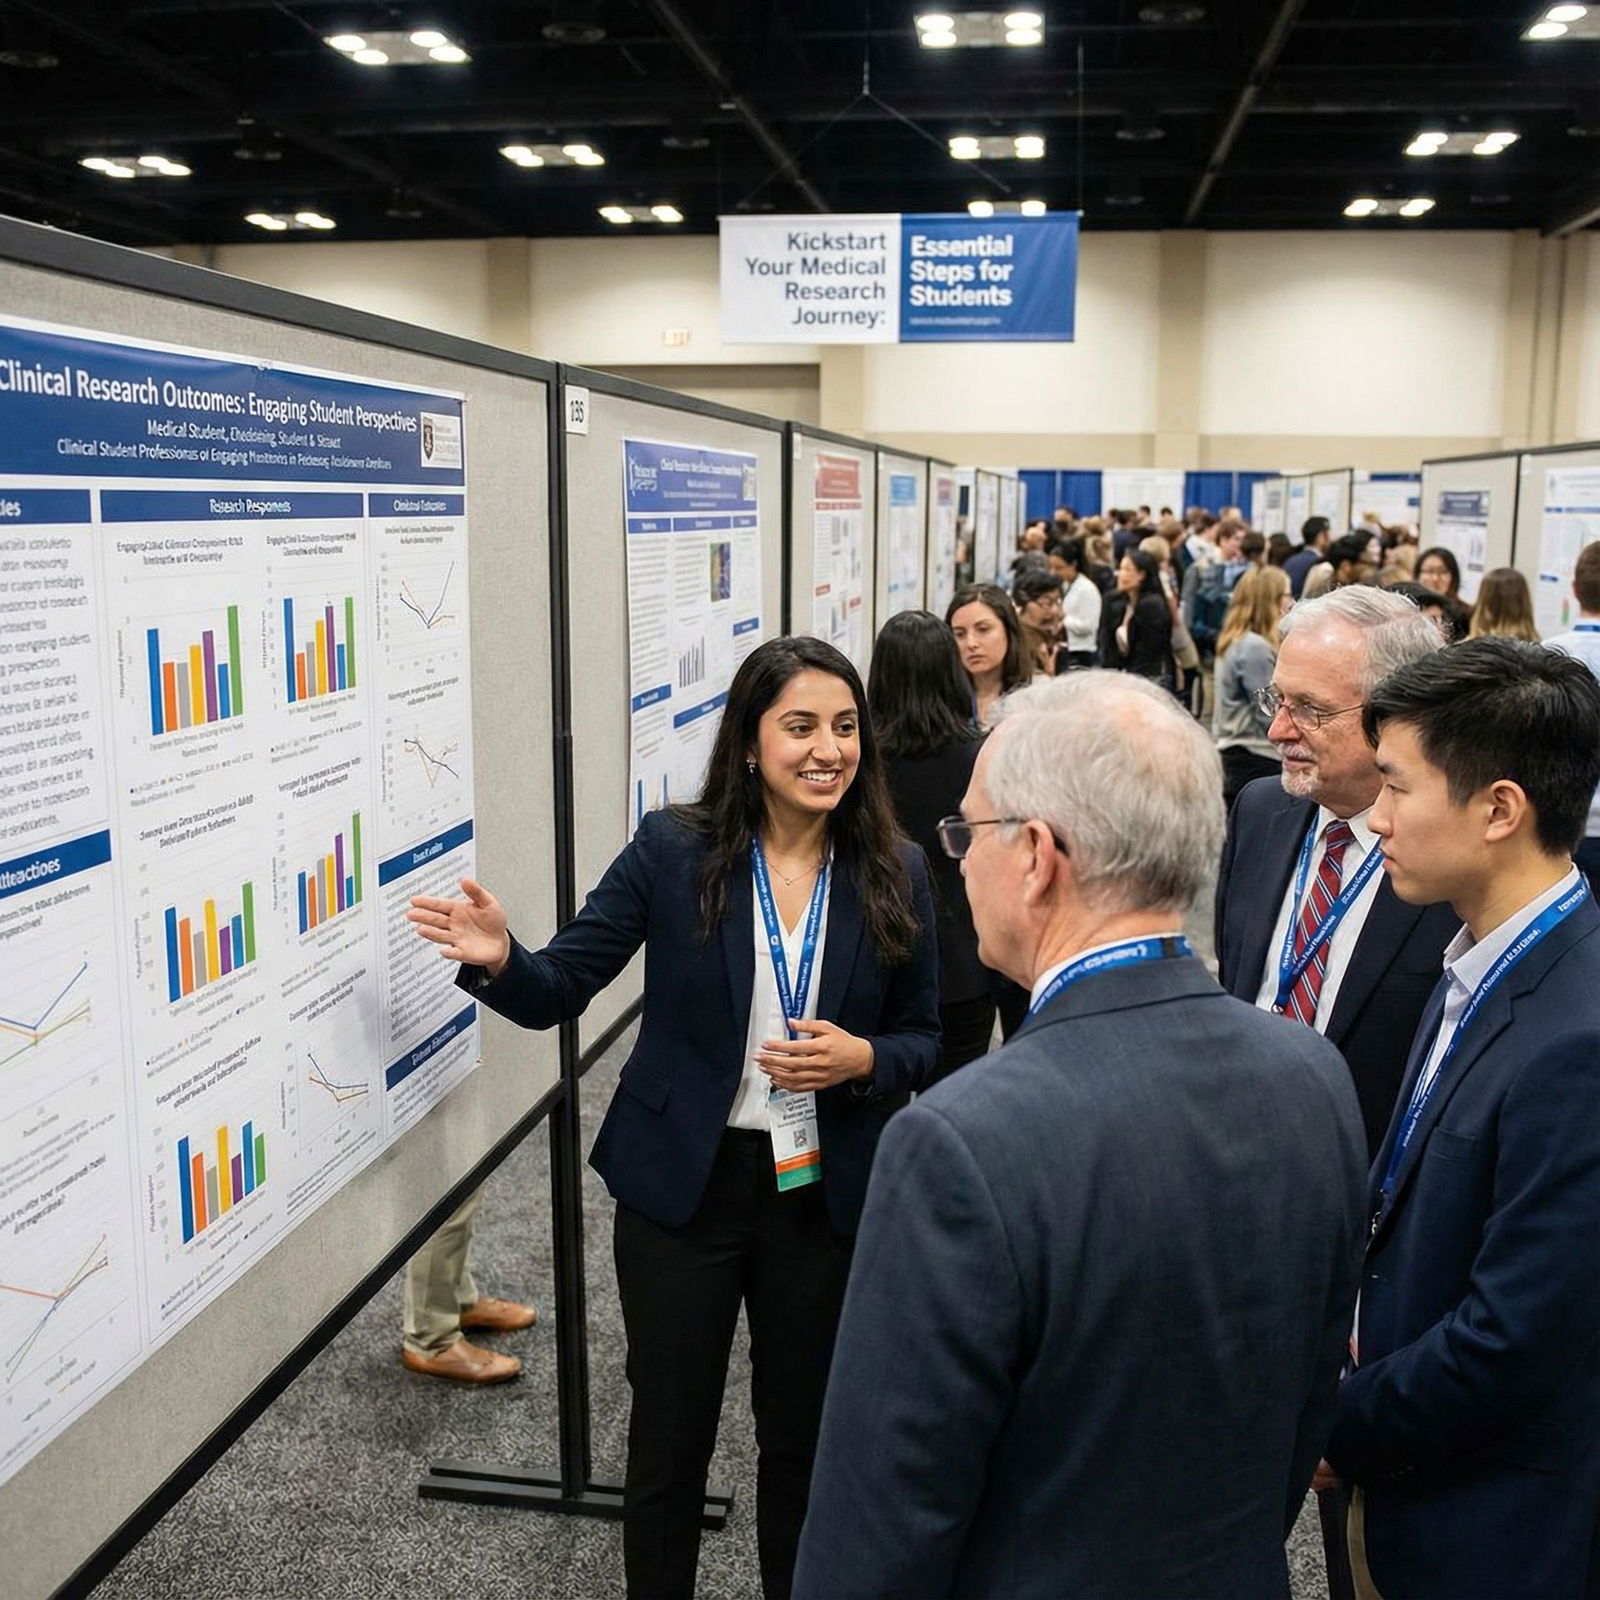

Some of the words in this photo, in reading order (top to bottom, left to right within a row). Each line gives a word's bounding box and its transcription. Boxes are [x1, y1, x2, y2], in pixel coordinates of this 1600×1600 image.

[787, 232, 887, 251] Kickstart
[910, 234, 1013, 257] Essential
[746, 258, 794, 276] Your
[801, 257, 886, 276] Medical
[910, 260, 975, 285] Steps
[979, 259, 1013, 282] for
[785, 282, 886, 300] Research
[910, 284, 1013, 307] Students
[792, 307, 886, 329] Journey:
[0, 359, 71, 397] Clinical
[77, 369, 159, 405] Research
[163, 381, 246, 414] Outcomes:
[249, 391, 307, 426] Engaging
[310, 400, 354, 426] Student
[356, 406, 418, 433] Perspectives
[147, 419, 187, 438] Medical
[57, 438, 97, 456] Clinical
[100, 441, 137, 459] Student
